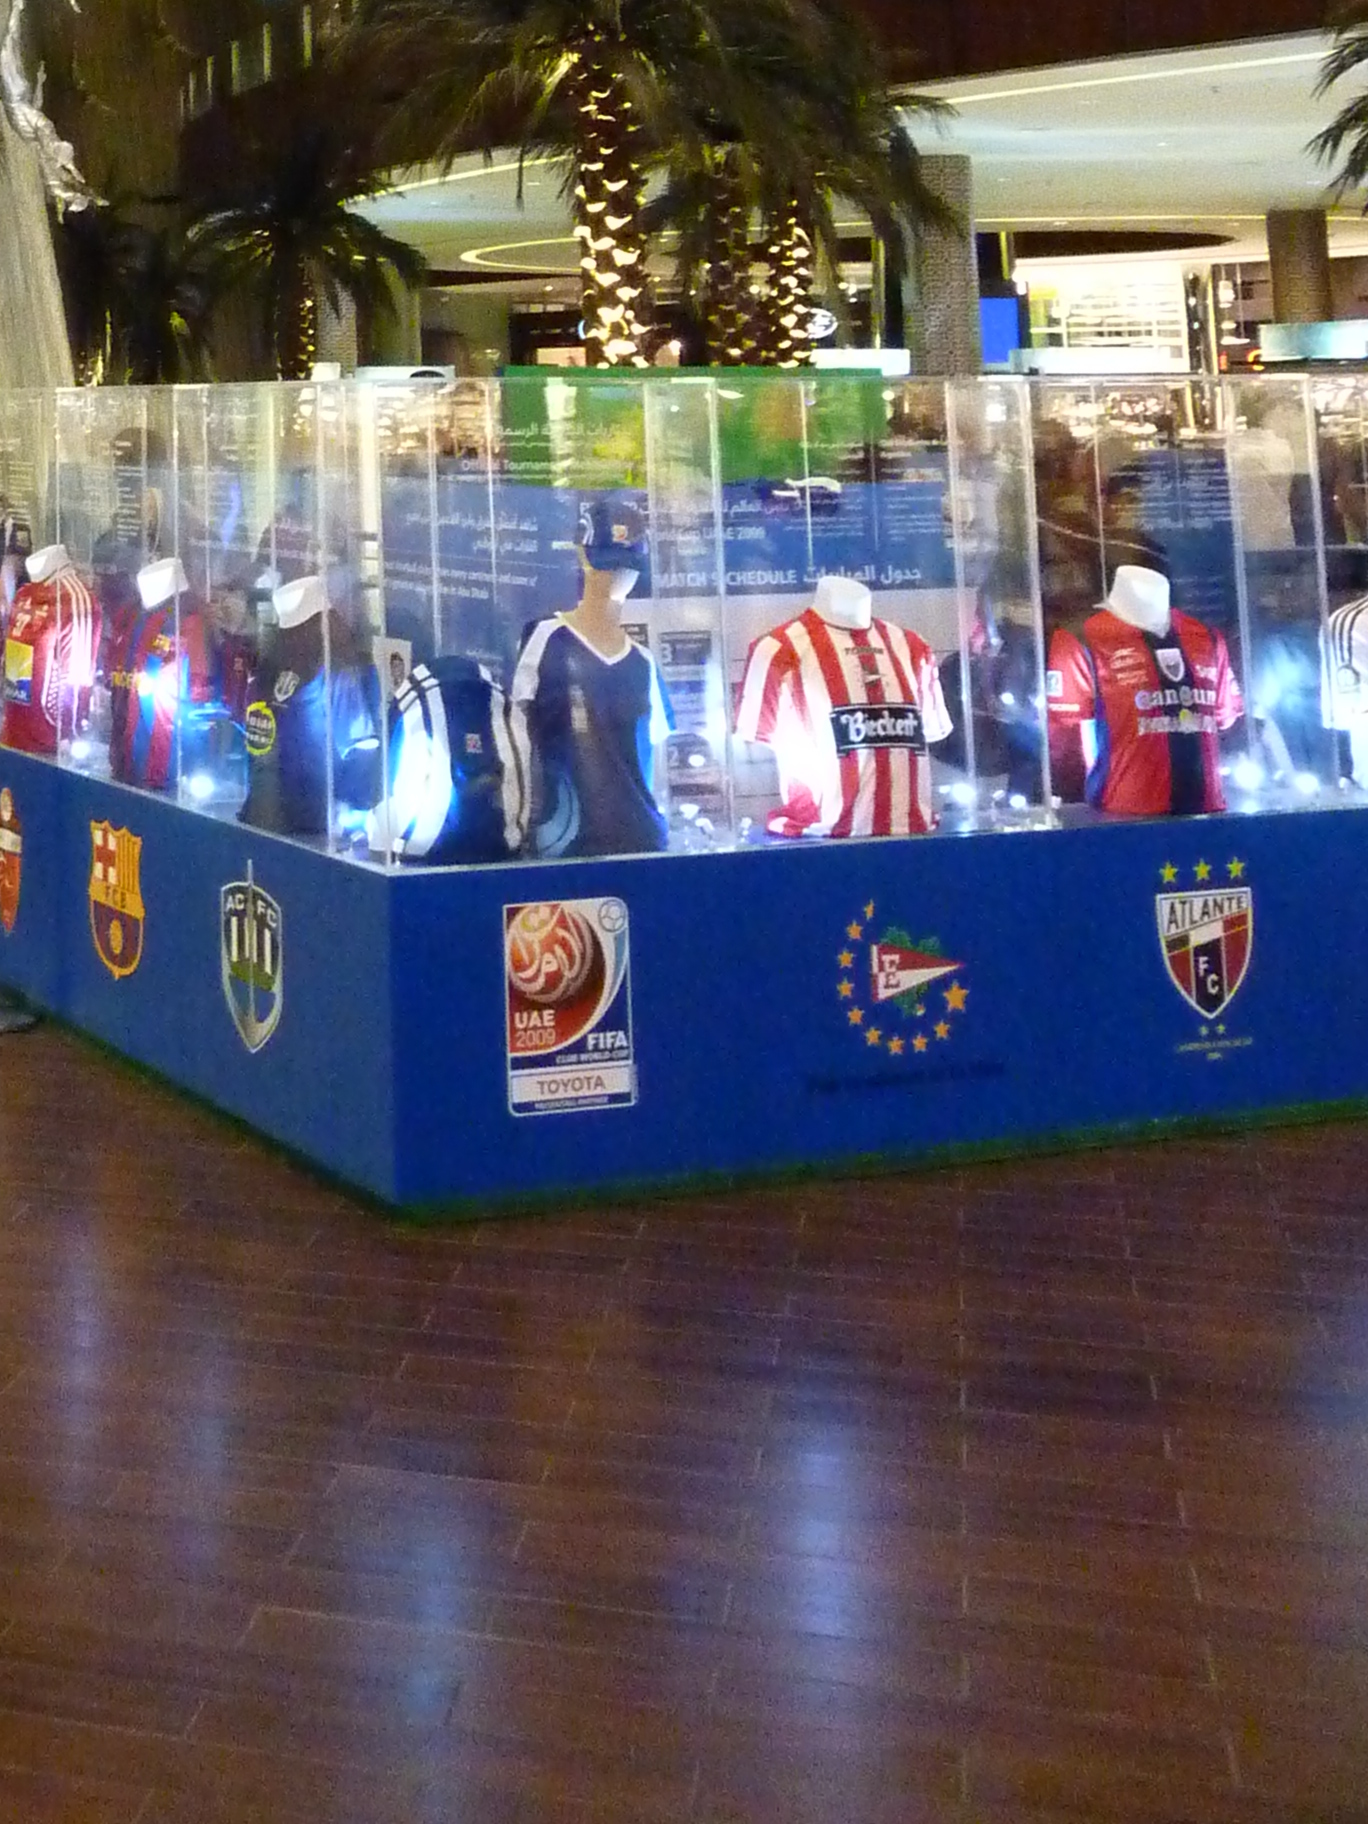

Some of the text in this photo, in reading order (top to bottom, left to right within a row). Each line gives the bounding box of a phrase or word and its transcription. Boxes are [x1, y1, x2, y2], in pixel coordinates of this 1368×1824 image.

[1166, 896, 1243, 933] ATLANTE
[514, 1010, 555, 1028] UAE
[516, 1029, 556, 1047] 2009
[588, 1031, 628, 1050] FIFA
[537, 1076, 606, 1094] TOYOTA
